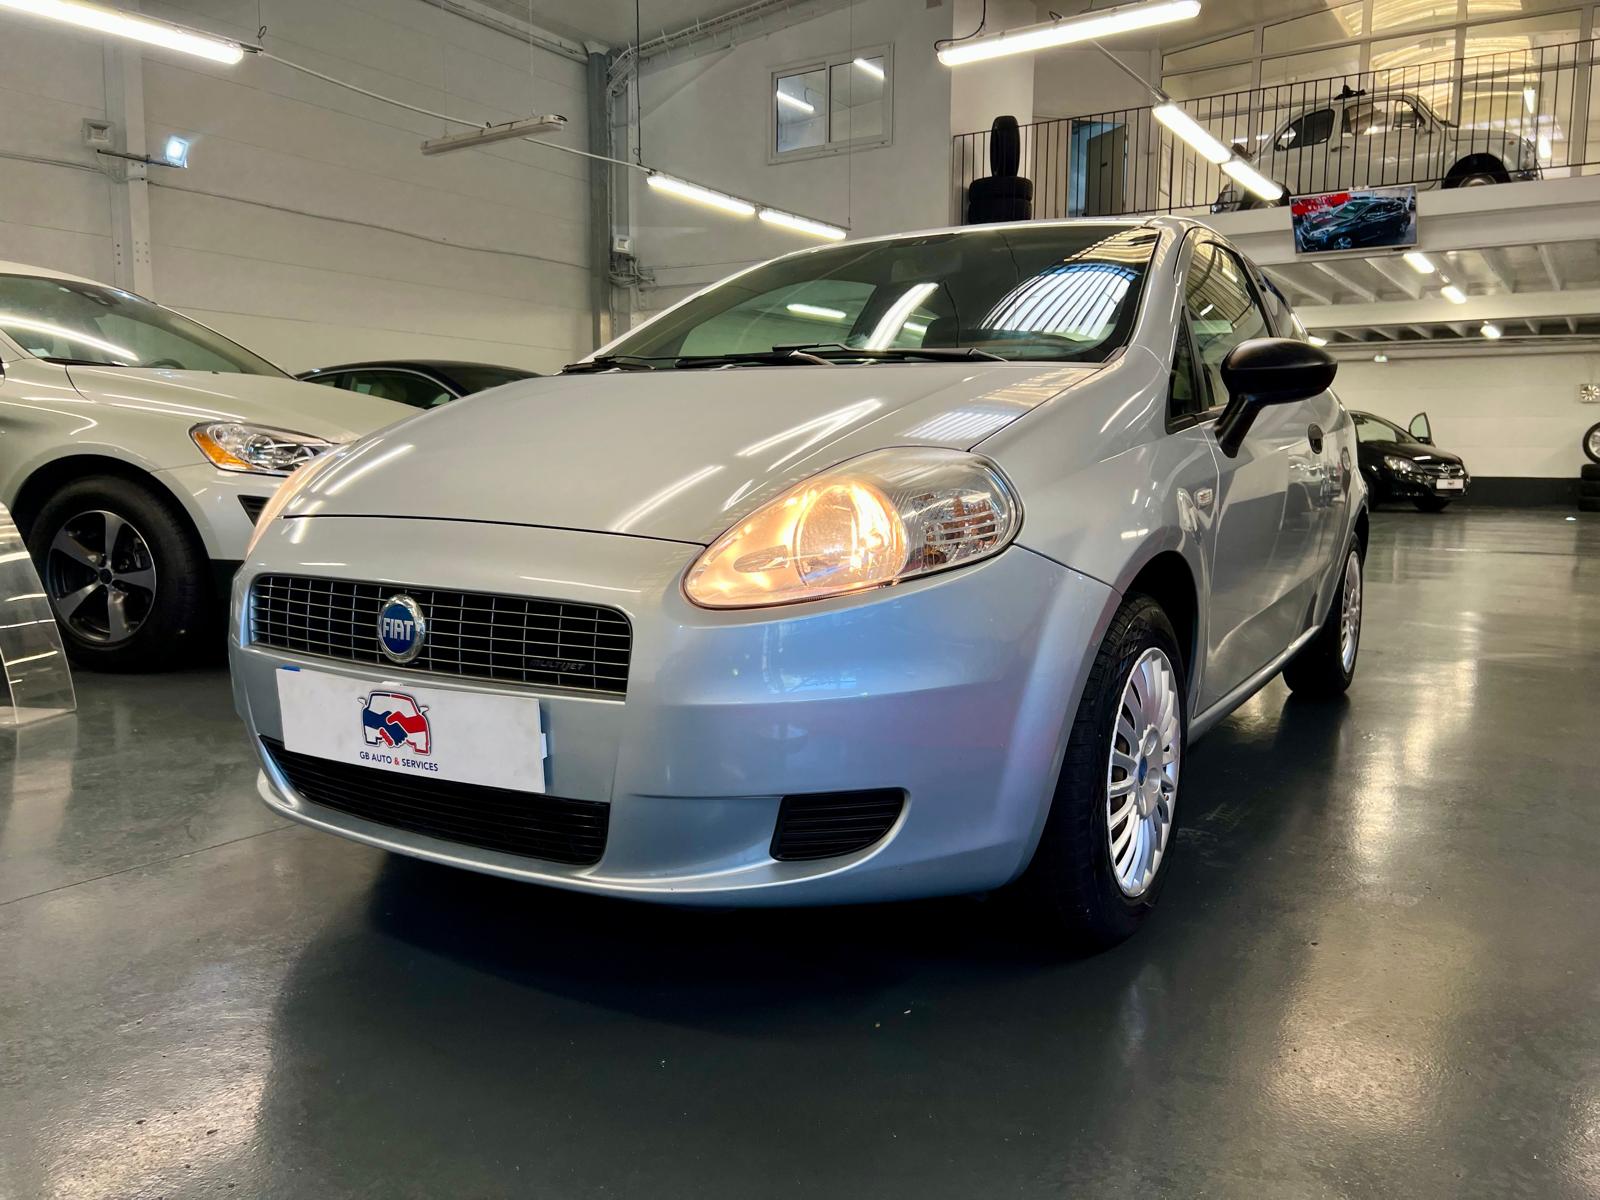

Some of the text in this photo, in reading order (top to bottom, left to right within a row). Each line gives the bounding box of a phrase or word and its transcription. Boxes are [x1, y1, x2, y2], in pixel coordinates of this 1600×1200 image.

[383, 617, 414, 641] FIAT
[359, 751, 439, 771] GB AUTO & SERVICES
